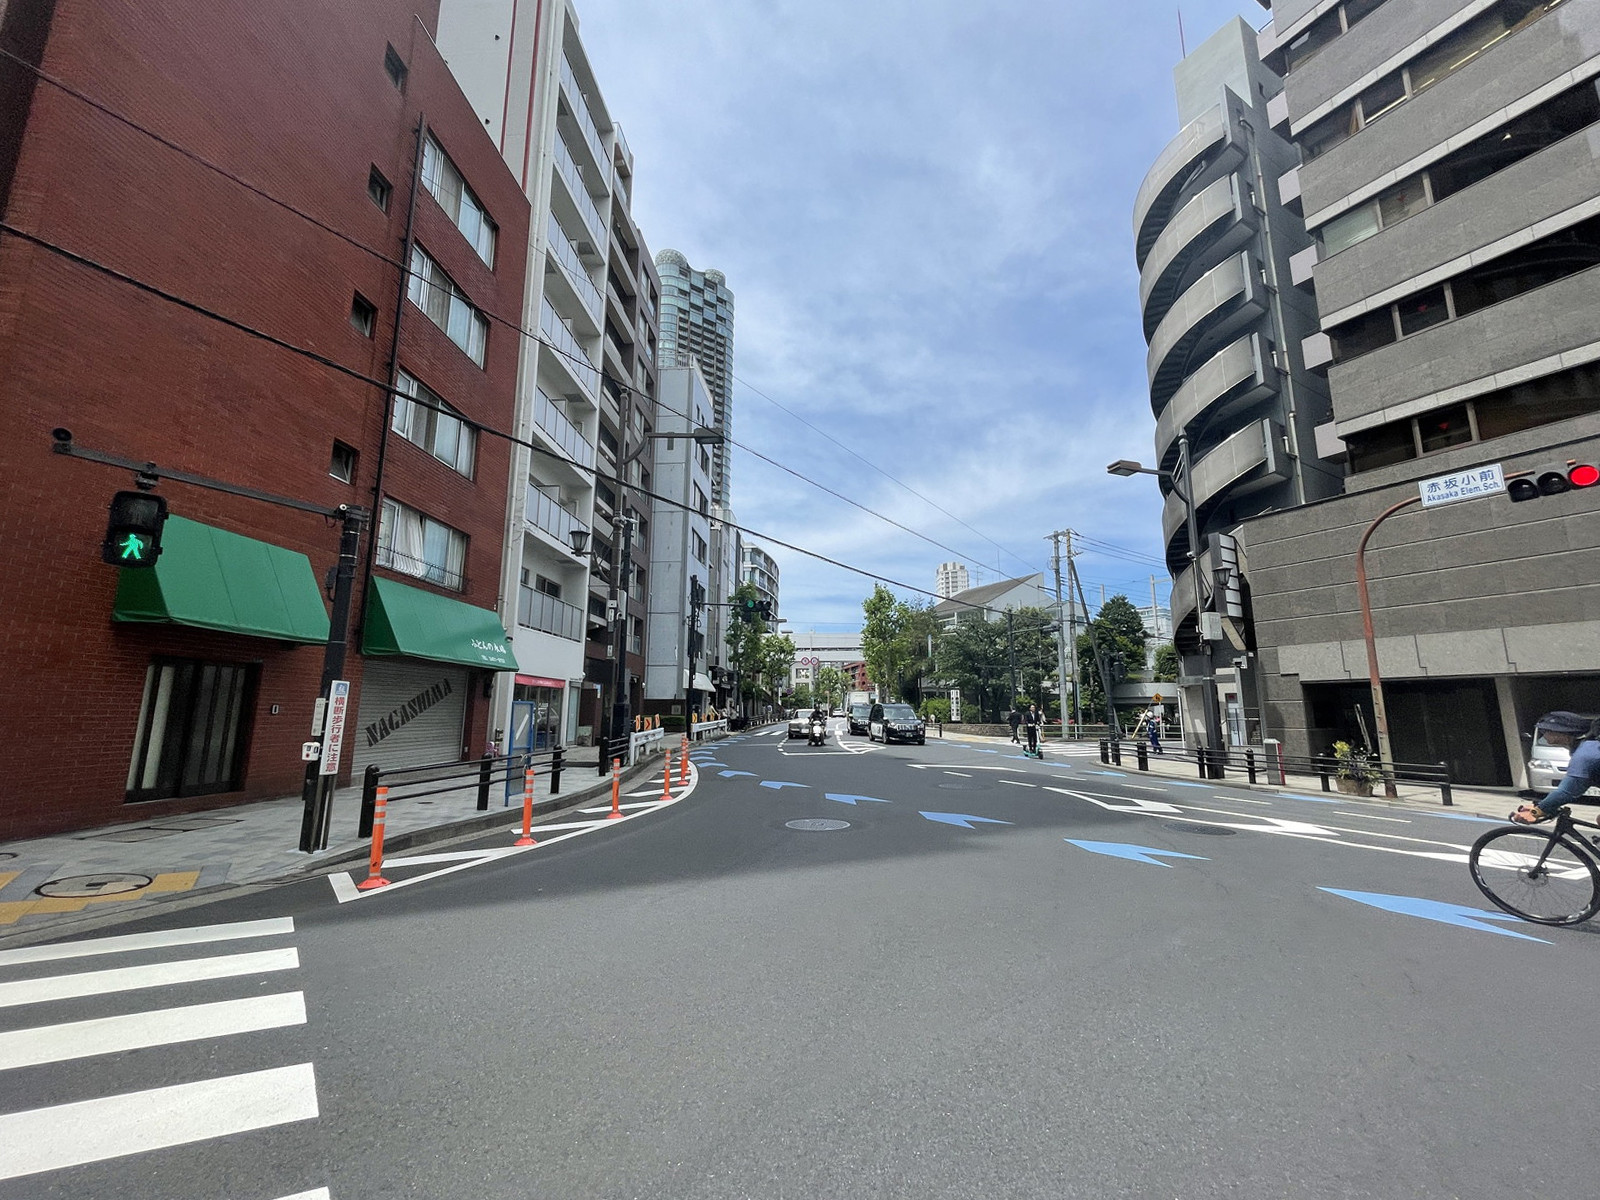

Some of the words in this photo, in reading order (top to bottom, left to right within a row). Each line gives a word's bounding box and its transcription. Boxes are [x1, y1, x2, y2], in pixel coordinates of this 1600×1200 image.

[1427, 470, 1495, 493] 赤坂小前
[1427, 490, 1459, 502] Akasaka
[1460, 486, 1482, 495] Elem.
[1483, 482, 1501, 492] Sch.
[325, 696, 346, 773] 横断歩行者に注意
[365, 678, 453, 748] NAGASHIMA
